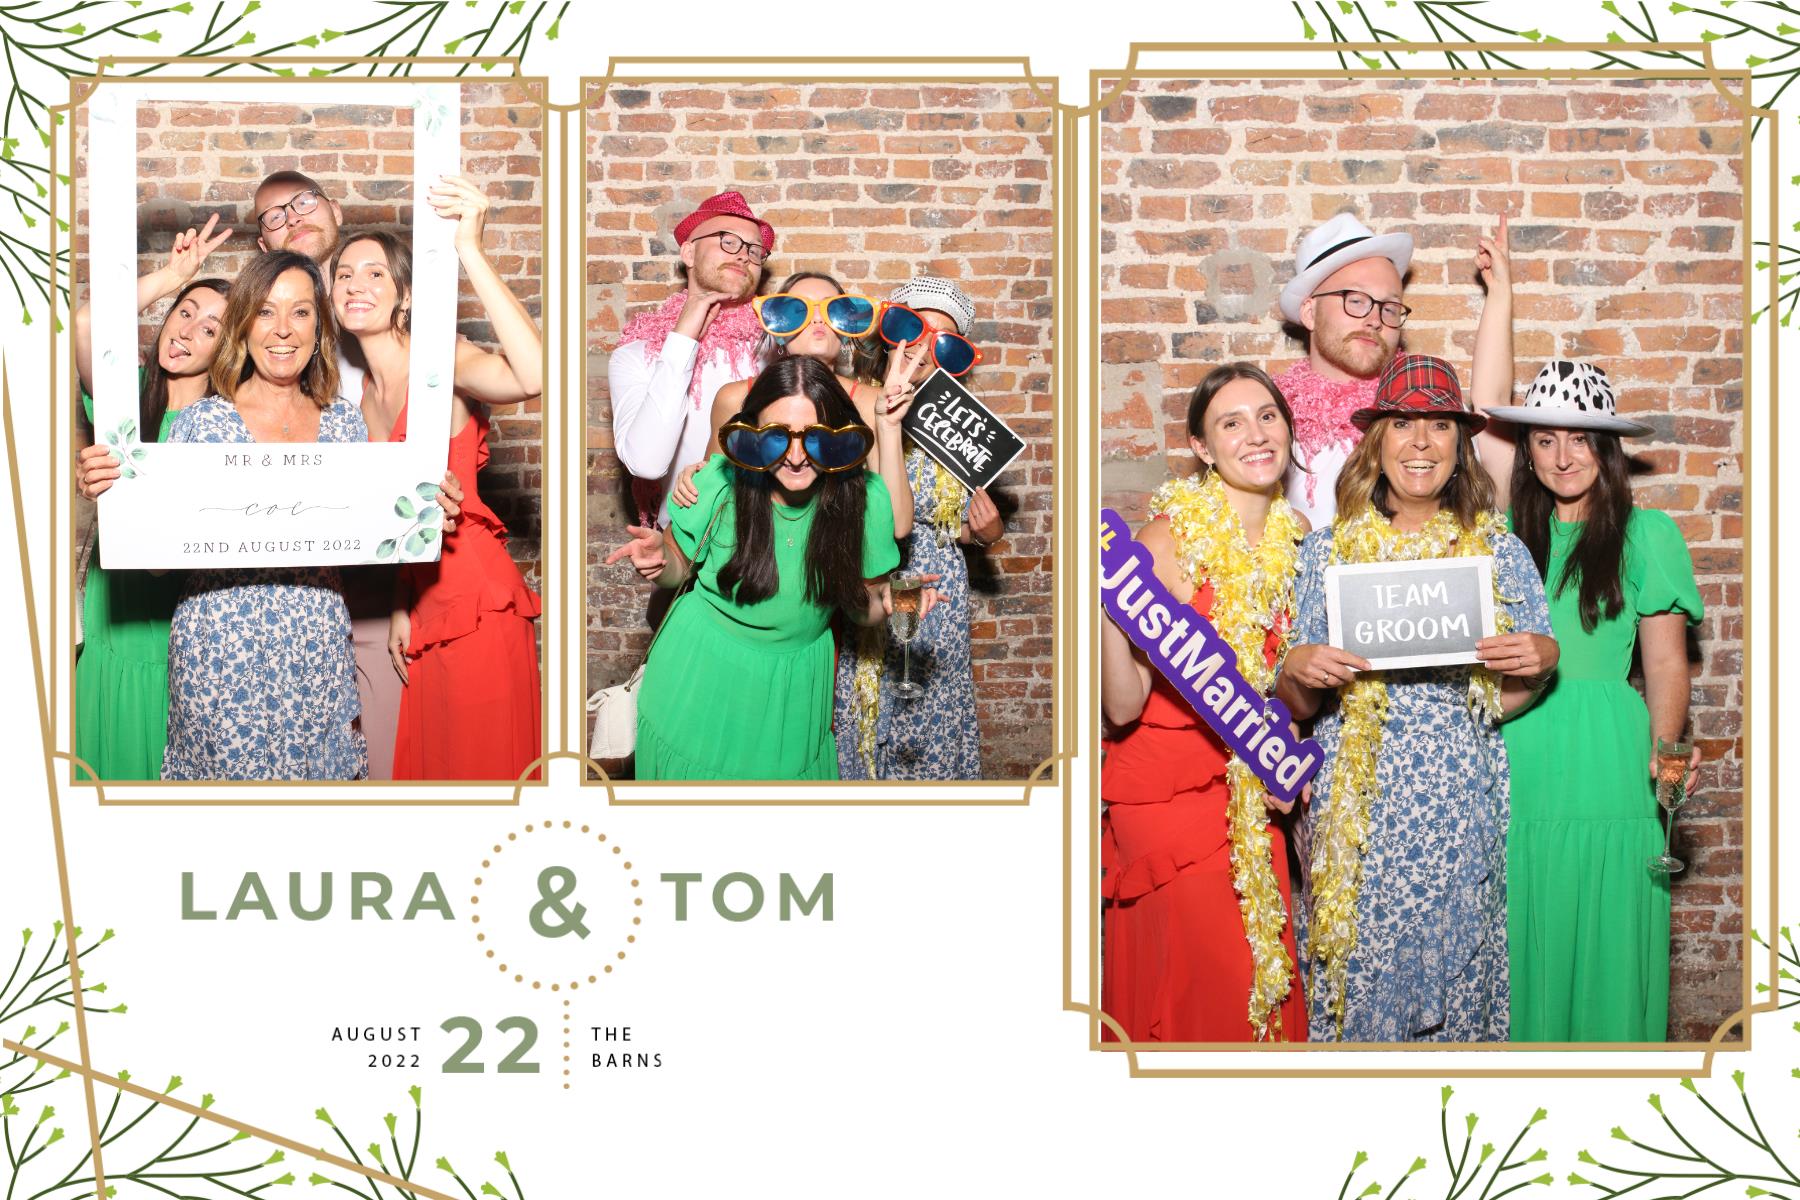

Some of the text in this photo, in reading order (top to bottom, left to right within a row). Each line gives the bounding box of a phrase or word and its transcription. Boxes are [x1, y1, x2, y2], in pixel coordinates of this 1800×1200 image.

[943, 396, 987, 438] LET'S
[917, 402, 993, 473] CELEBRATE
[224, 454, 323, 467] MR & MRS
[183, 539, 361, 554] 22ND AUGUST 2022
[1372, 580, 1449, 609] TEAM
[1354, 613, 1471, 645] GROOM
